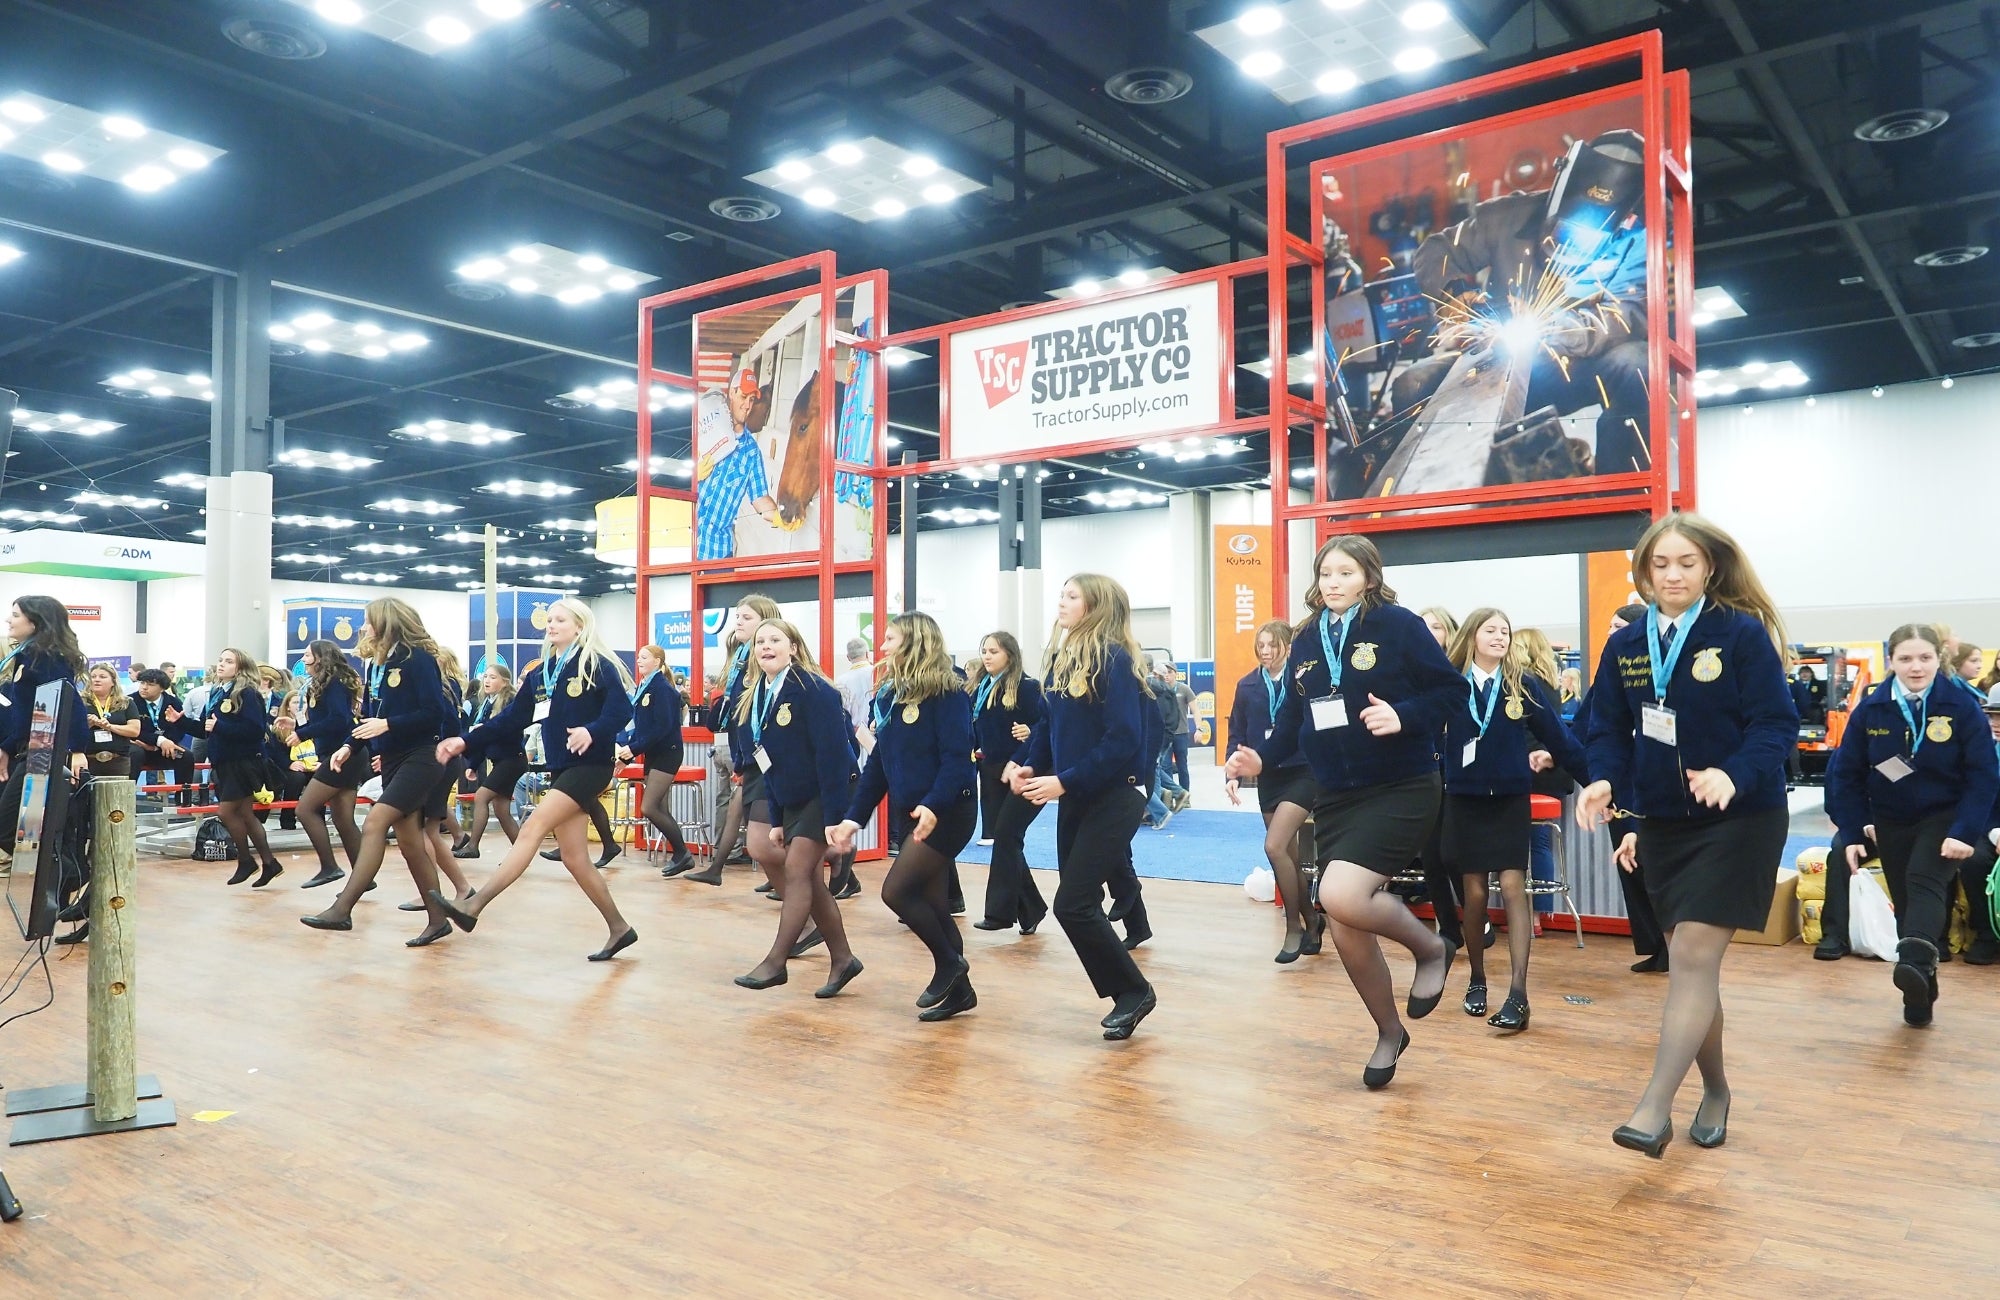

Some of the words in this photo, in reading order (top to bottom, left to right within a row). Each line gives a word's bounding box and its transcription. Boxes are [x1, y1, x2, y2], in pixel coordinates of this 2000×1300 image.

[1031, 307, 1189, 368] TRACTOR
[980, 348, 1020, 393] TSC
[1031, 352, 1149, 404] SUPPLY
[1032, 393, 1189, 428] TractorSupply.com
[121, 548, 152, 559] ADM
[1226, 557, 1262, 566] Kubota
[1235, 583, 1255, 634] TURF
[670, 634, 691, 644] Loun
